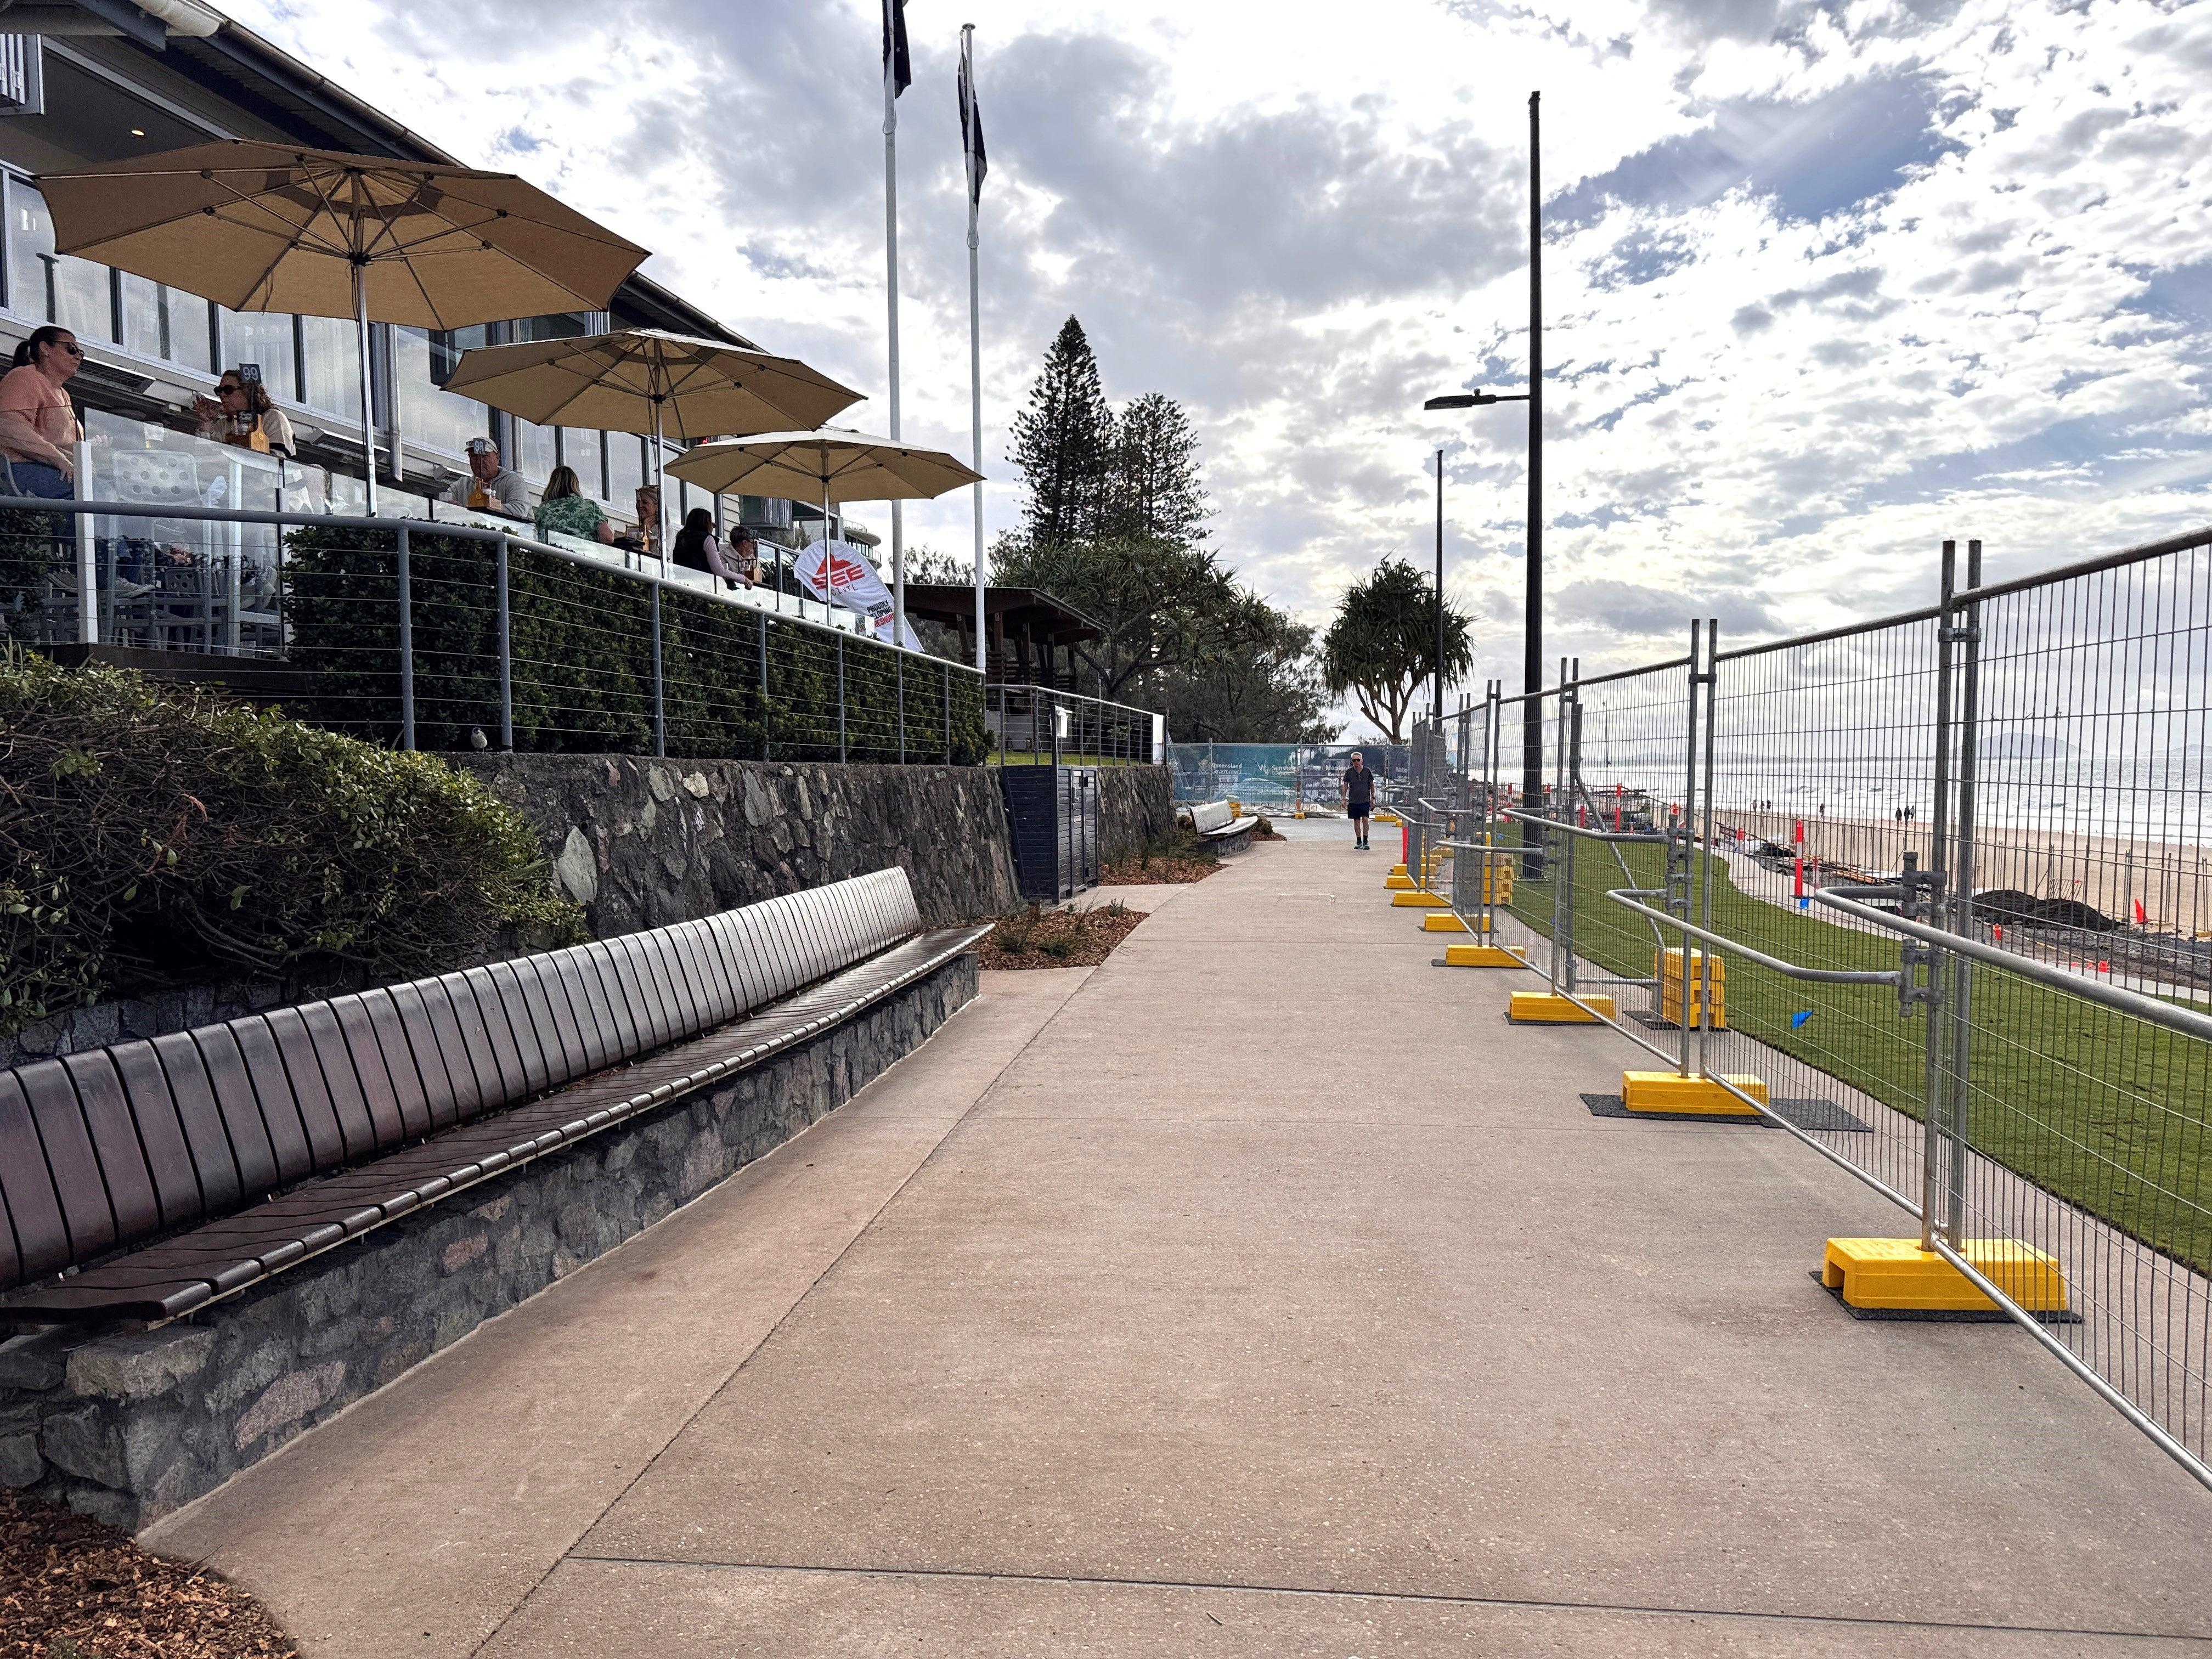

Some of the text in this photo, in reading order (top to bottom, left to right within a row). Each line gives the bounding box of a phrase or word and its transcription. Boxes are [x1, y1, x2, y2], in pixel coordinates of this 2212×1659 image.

[242, 366, 259, 381] 99
[475, 440, 484, 452] 98
[749, 529, 758, 538] 97
[812, 564, 865, 590] SEE
[867, 600, 889, 613] PROUDLY
